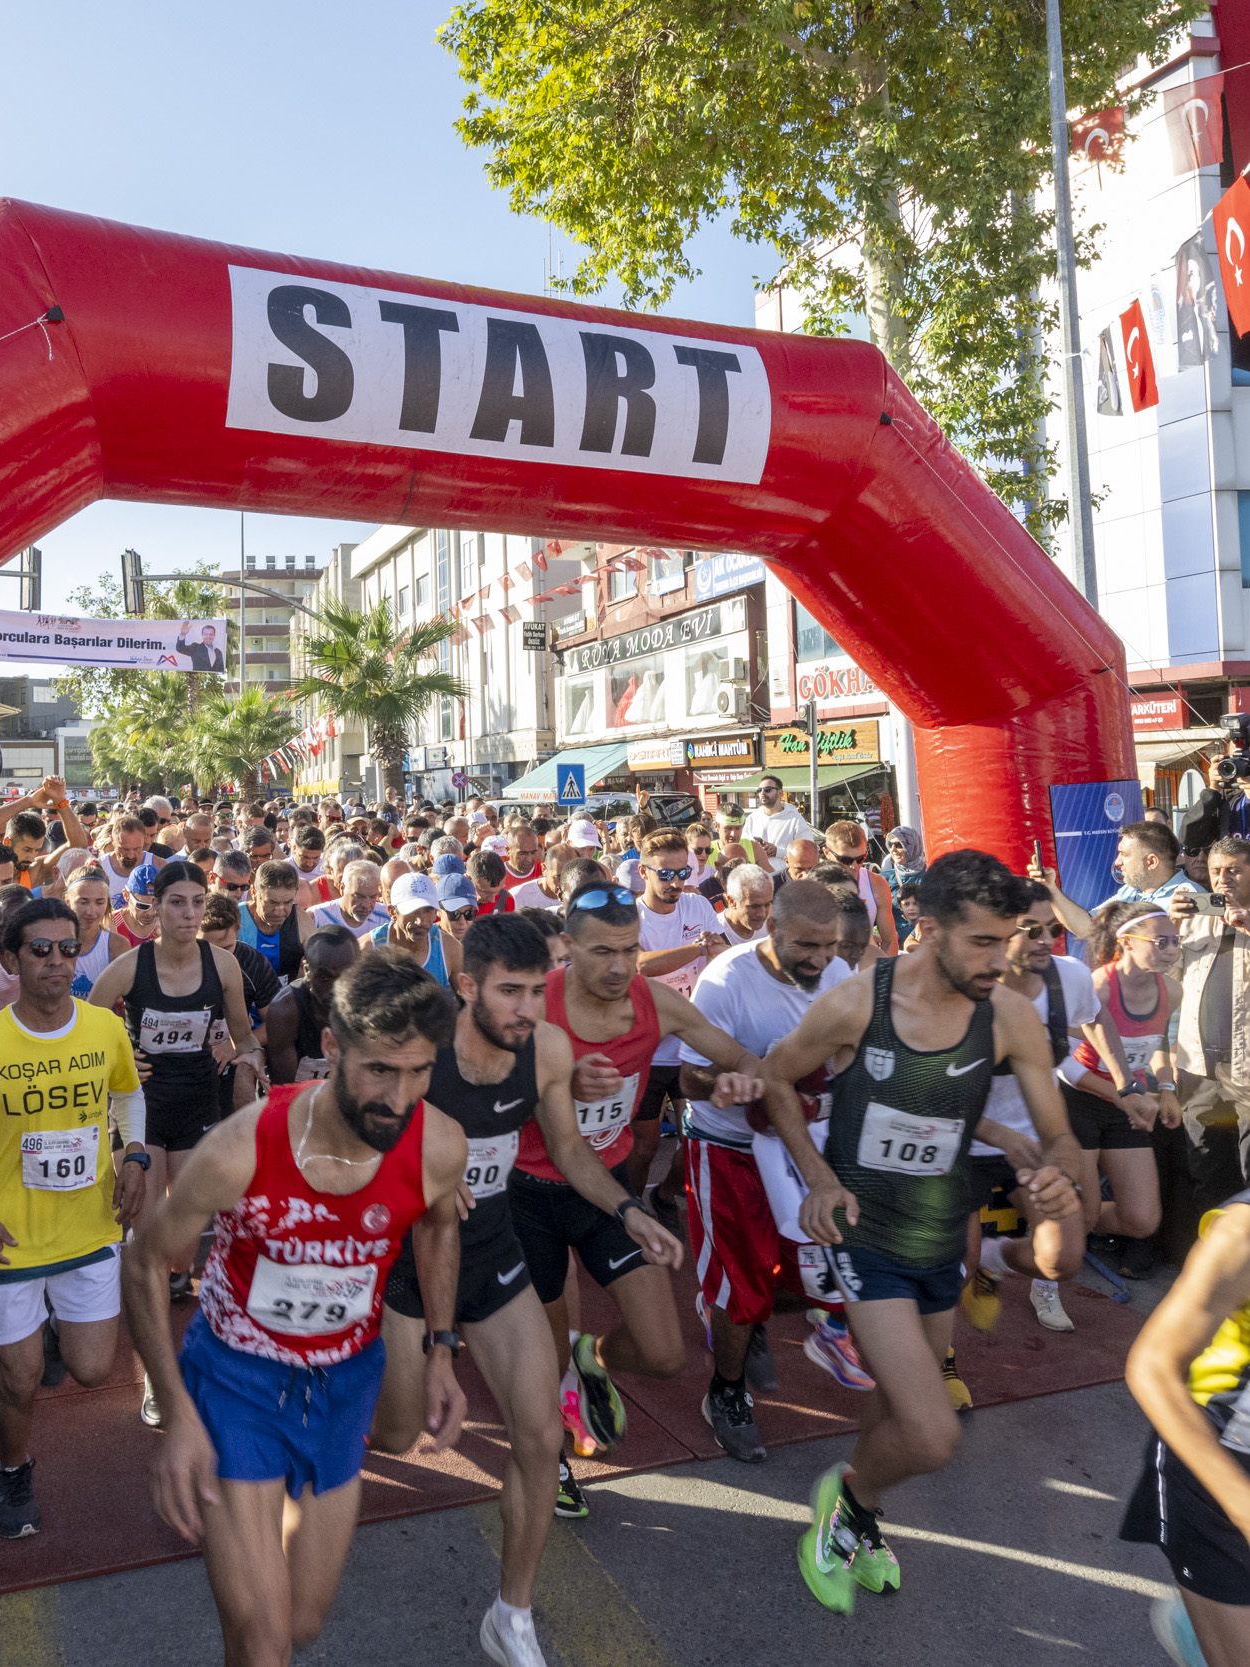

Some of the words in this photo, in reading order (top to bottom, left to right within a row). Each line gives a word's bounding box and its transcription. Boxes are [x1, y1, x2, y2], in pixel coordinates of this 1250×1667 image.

[266, 284, 742, 466] START
[54, 634, 114, 649] Başarılar
[117, 637, 166, 650] Dilerim.
[582, 640, 620, 670] RÜYA
[626, 624, 674, 657] MODA
[680, 610, 714, 642] EVİ
[1132, 699, 1177, 716] ARKÜTERİ
[778, 734, 806, 752] Han
[142, 1016, 159, 1028] 494
[152, 1031, 193, 1045] 494
[68, 1051, 105, 1072] ADIM
[2, 1078, 104, 1116] LÖSEV
[578, 1102, 623, 1124] 115
[22, 1138, 42, 1150] 496
[880, 1139, 938, 1163] 108
[39, 1155, 85, 1178] 160
[467, 1165, 499, 1186] 90
[265, 1235, 391, 1264] TÜRKİYE
[270, 1298, 346, 1322] 279
